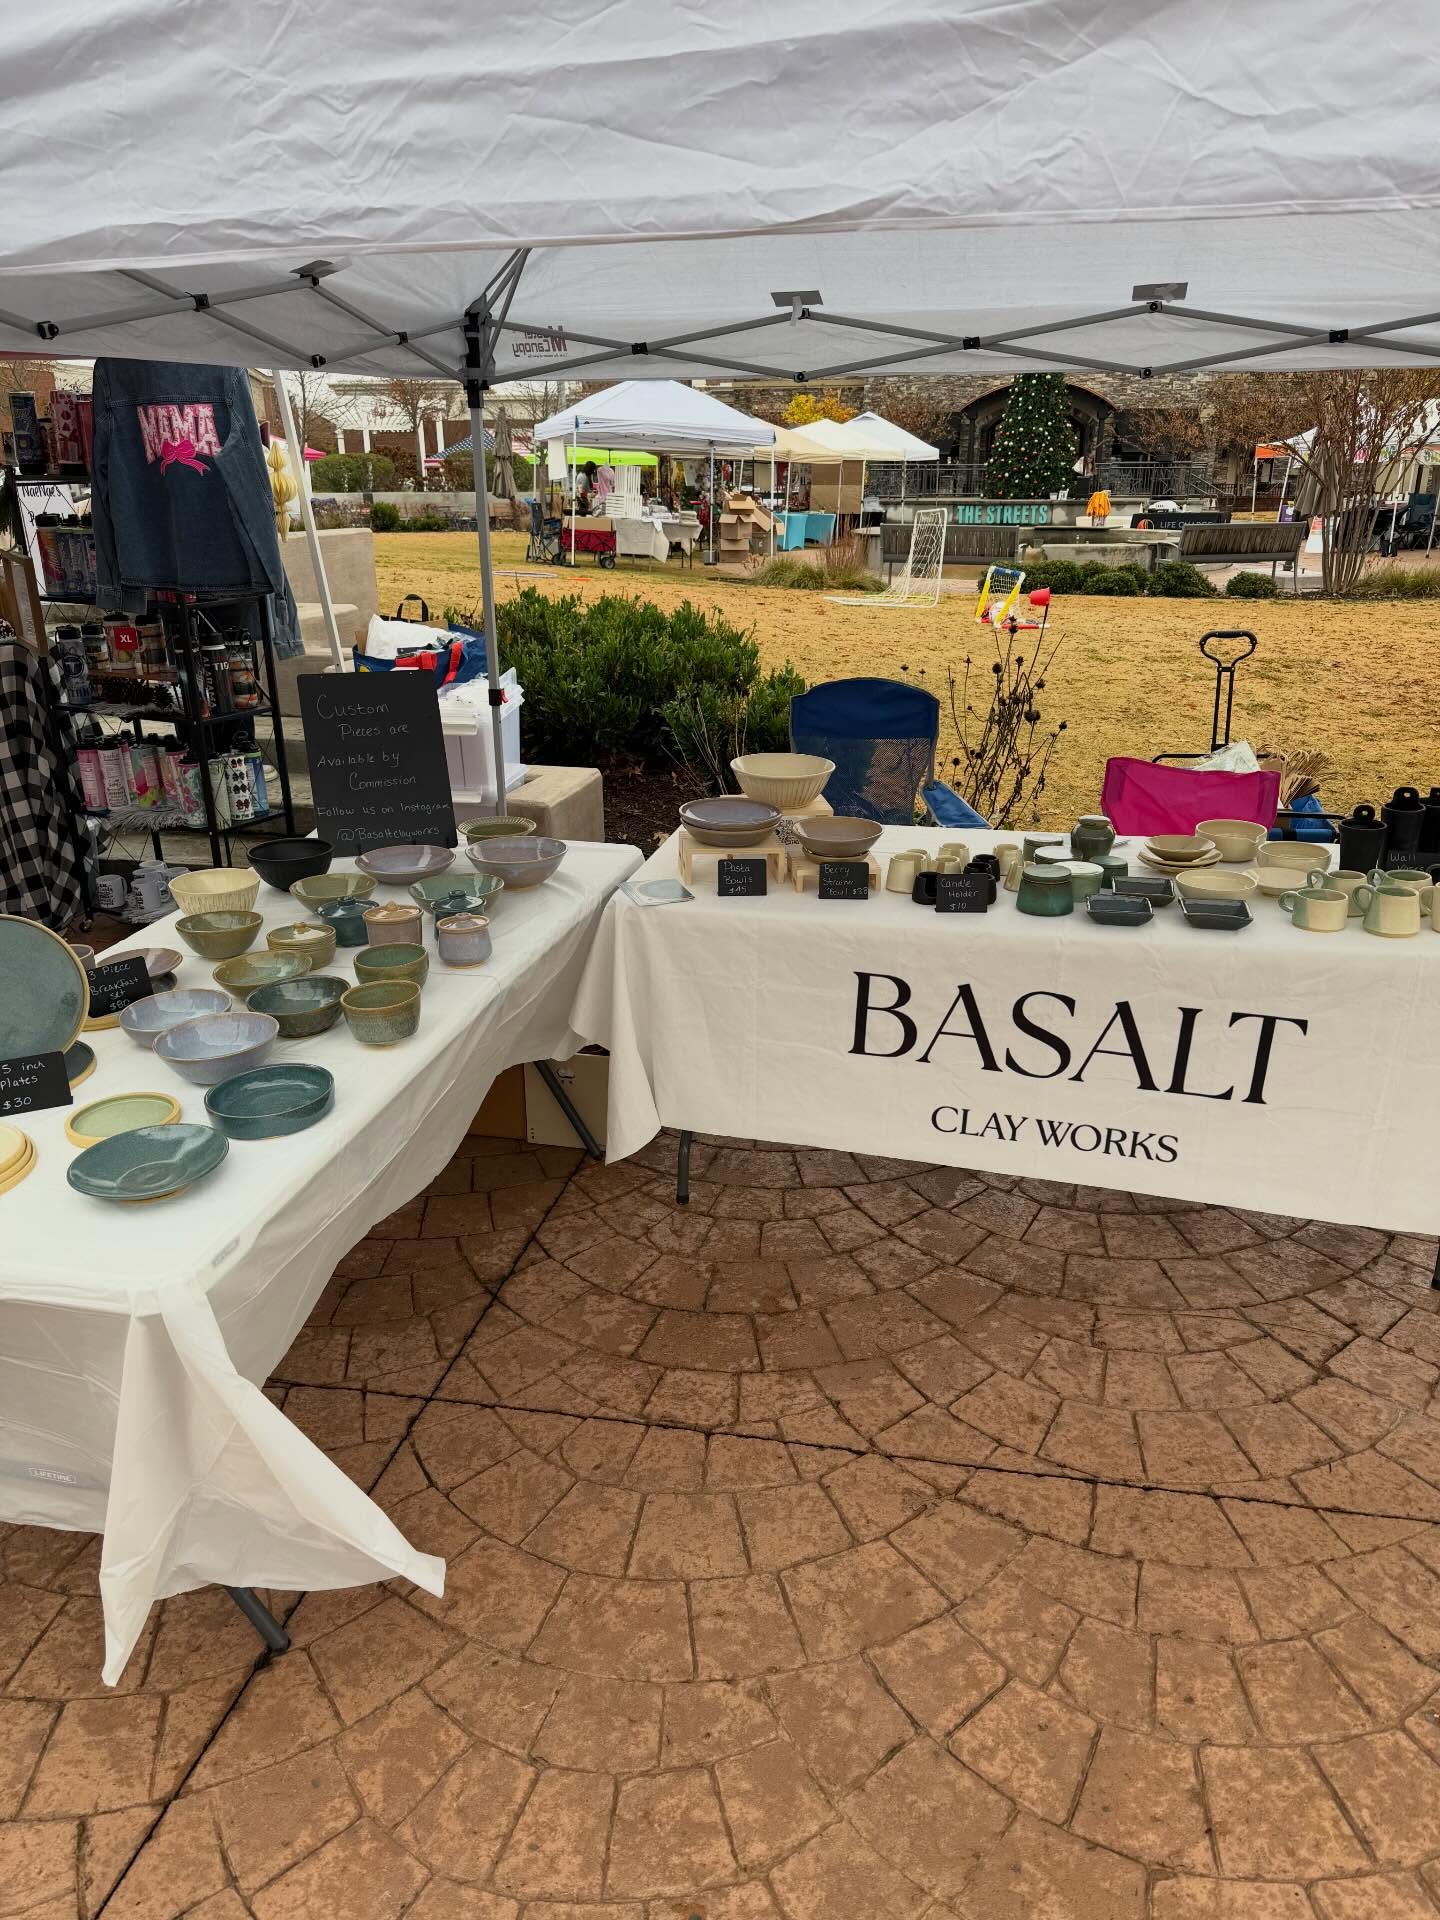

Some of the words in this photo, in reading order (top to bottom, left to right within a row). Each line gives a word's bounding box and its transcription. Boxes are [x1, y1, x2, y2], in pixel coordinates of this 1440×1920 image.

[137, 403, 222, 464] MAMA
[957, 505, 982, 524] THE
[986, 505, 1048, 524] STREETS
[120, 634, 132, 643] XL
[316, 694, 390, 719] Custom
[337, 723, 381, 739] Pieces
[389, 724, 409, 735] are
[317, 755, 375, 767] Available
[382, 751, 400, 768] by
[317, 806, 355, 816] Follow
[362, 806, 376, 815] us
[381, 806, 394, 814] on
[400, 801, 450, 814] Instagram
[1390, 852, 1416, 862] Wall
[723, 861, 751, 873] Pasta
[824, 863, 850, 878] Berry
[723, 875, 753, 885] Bowls
[940, 877, 973, 888] Candle
[948, 890, 979, 898] Holder
[950, 902, 967, 911] $10
[88, 970, 97, 980] 3
[102, 963, 131, 975] Piece
[89, 976, 139, 996] Breakfast
[109, 998, 131, 1010] $80
[848, 971, 1308, 1104] BASALT
[22, 1060, 46, 1071] inch
[2, 1096, 32, 1110] $30
[931, 1106, 1028, 1142] CLAY
[1035, 1119, 1179, 1163] WORKS
